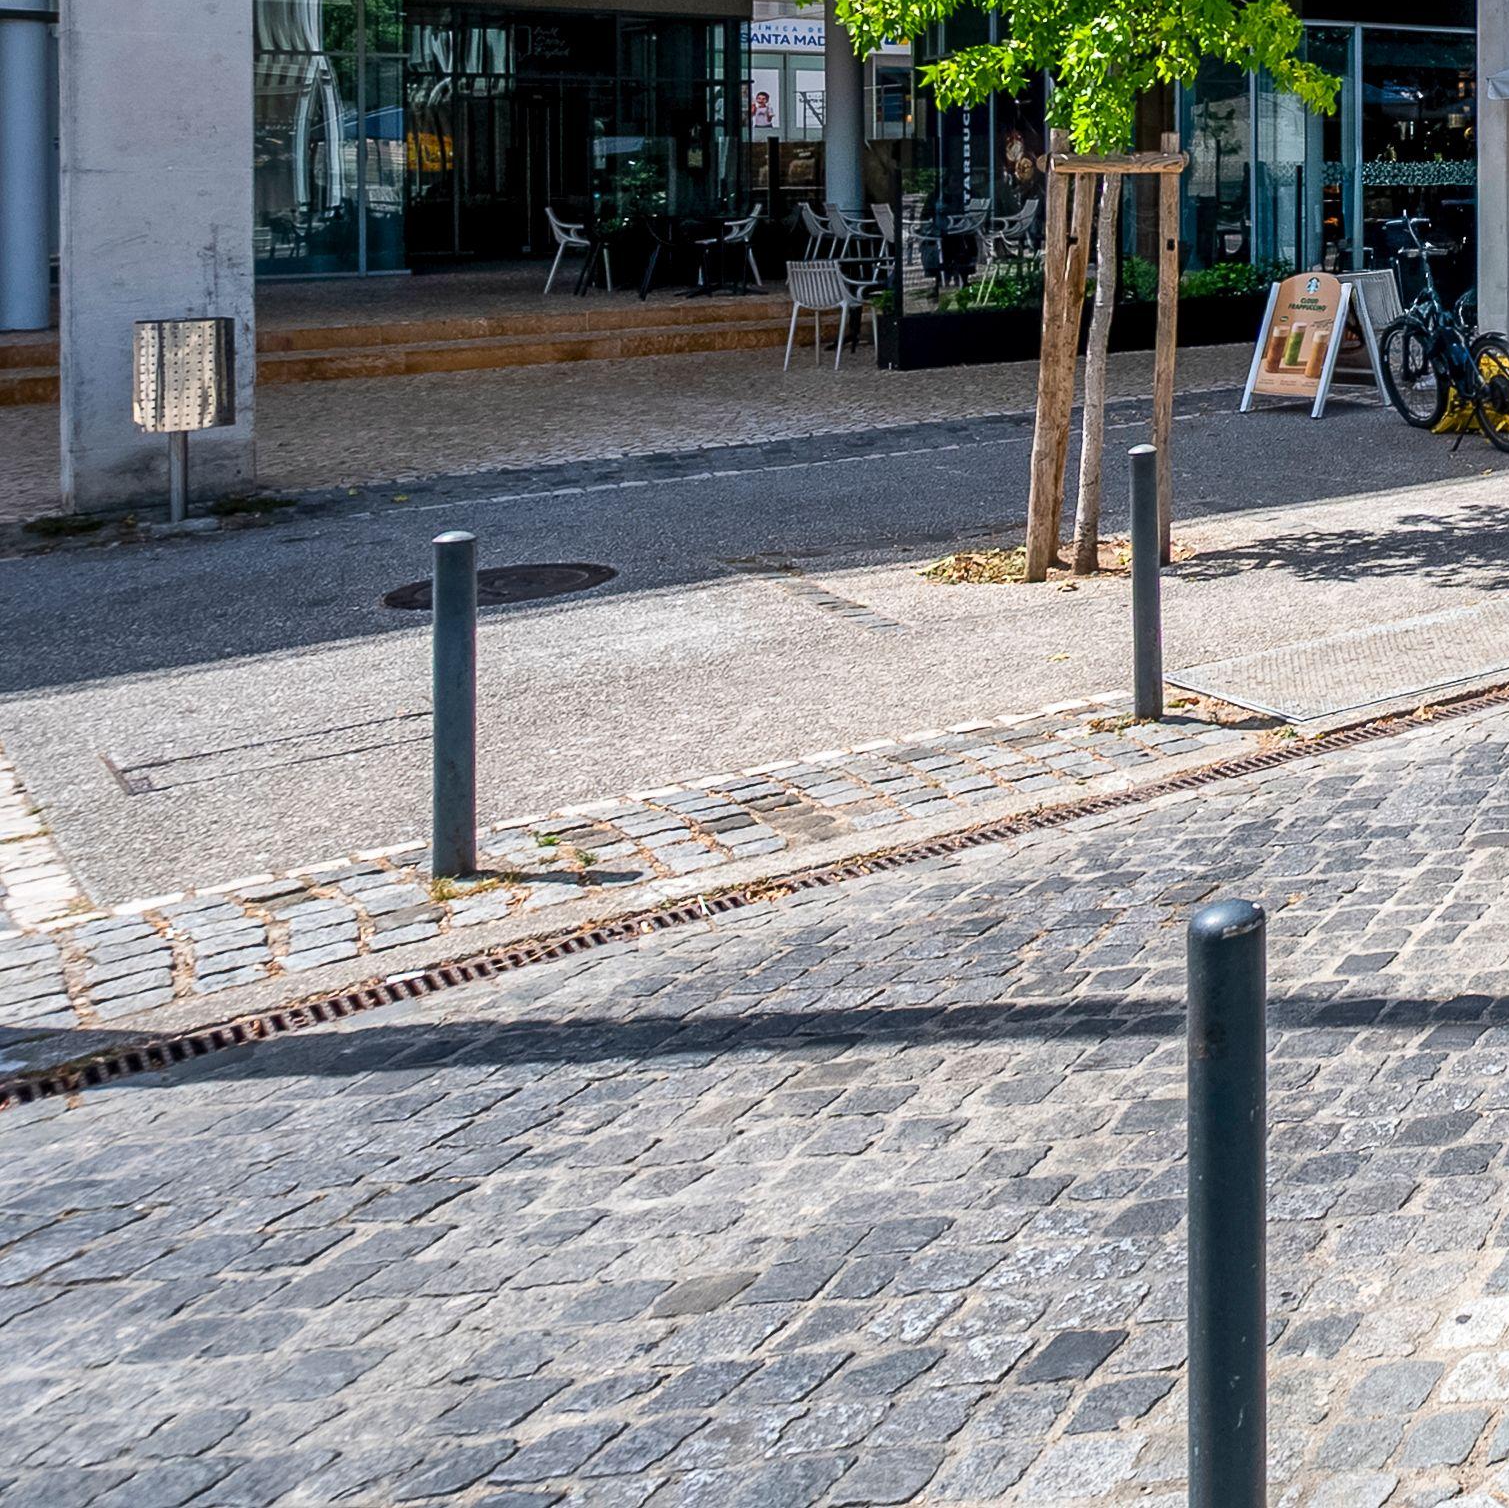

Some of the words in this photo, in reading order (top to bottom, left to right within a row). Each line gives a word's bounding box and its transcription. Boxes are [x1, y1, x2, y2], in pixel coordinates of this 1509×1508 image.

[752, 23, 799, 33] ÍNICA
[740, 32, 790, 46] SANTA
[793, 34, 826, 47] MAD
[962, 99, 972, 211] TARBUCK
